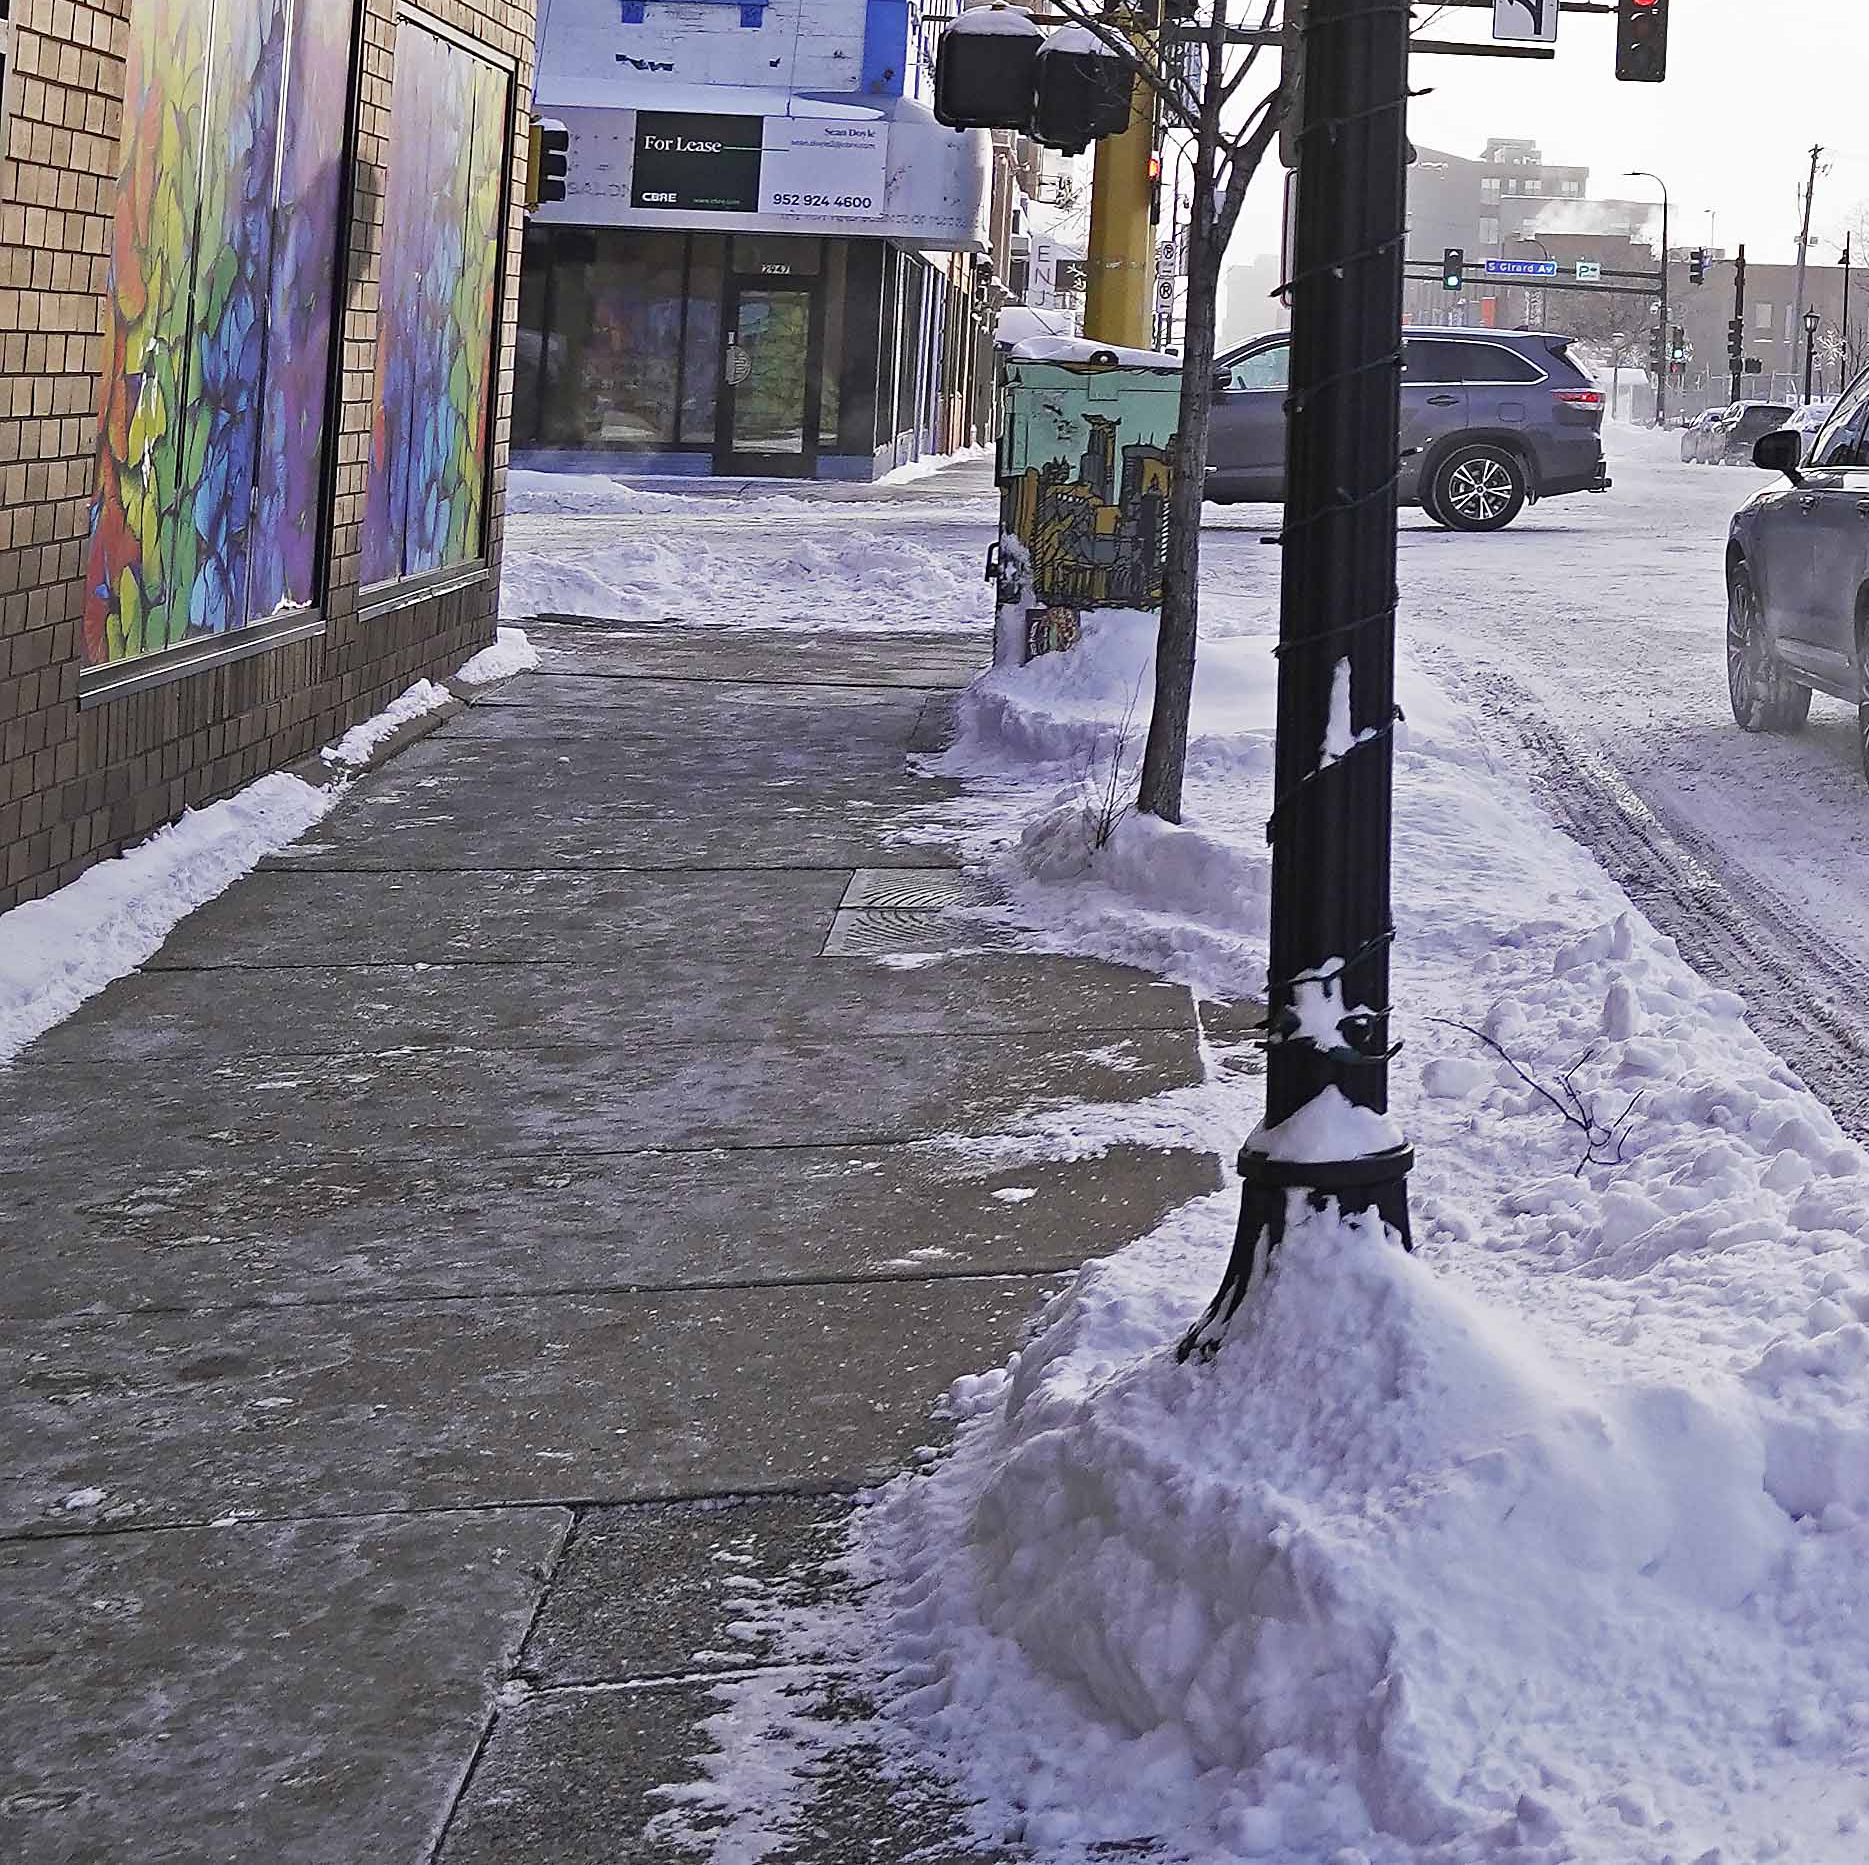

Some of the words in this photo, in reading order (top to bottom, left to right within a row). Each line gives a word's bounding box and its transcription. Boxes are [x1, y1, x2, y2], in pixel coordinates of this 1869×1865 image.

[644, 135, 674, 151] For
[676, 136, 722, 153] Lease
[641, 192, 678, 203] CBRE
[773, 193, 800, 206] 952
[803, 194, 830, 207] 924
[834, 195, 872, 209] 4600
[1487, 262, 1496, 272] S
[1500, 262, 1535, 273] Girard
